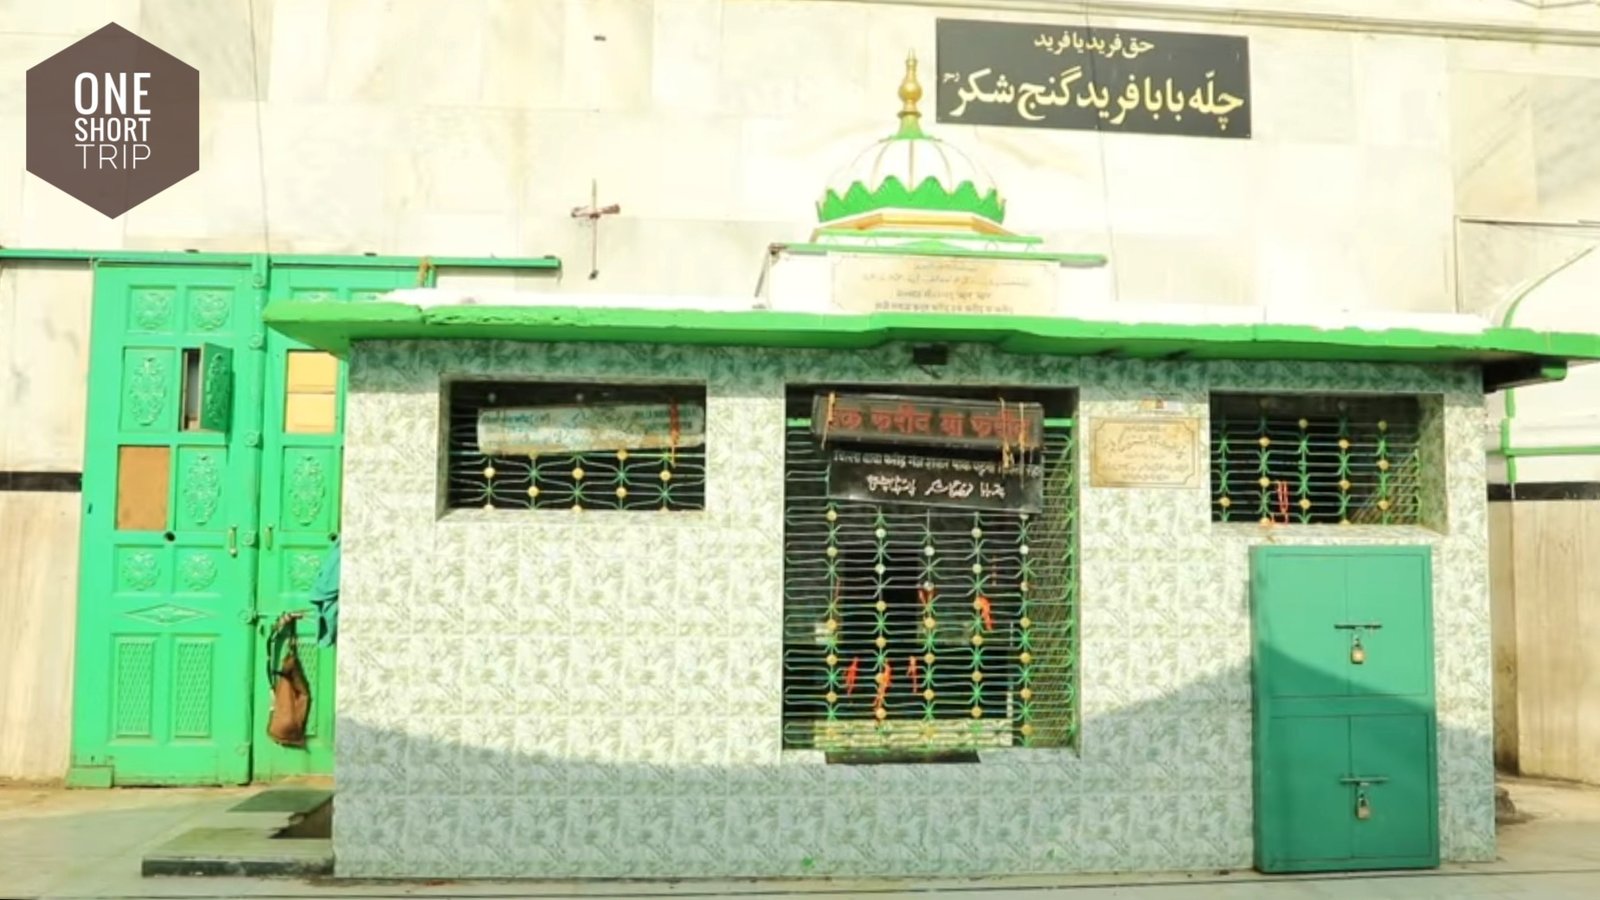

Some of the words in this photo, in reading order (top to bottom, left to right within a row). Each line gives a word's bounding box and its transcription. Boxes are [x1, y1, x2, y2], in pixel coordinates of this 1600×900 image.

[1034, 30, 1071, 55] فرید
[1085, 34, 1122, 58] فرید
[1122, 37, 1154, 58] حق
[949, 67, 1015, 117] شکر
[1017, 65, 1082, 120] گنج
[1077, 73, 1140, 125] فرید
[1144, 76, 1185, 121] بابا
